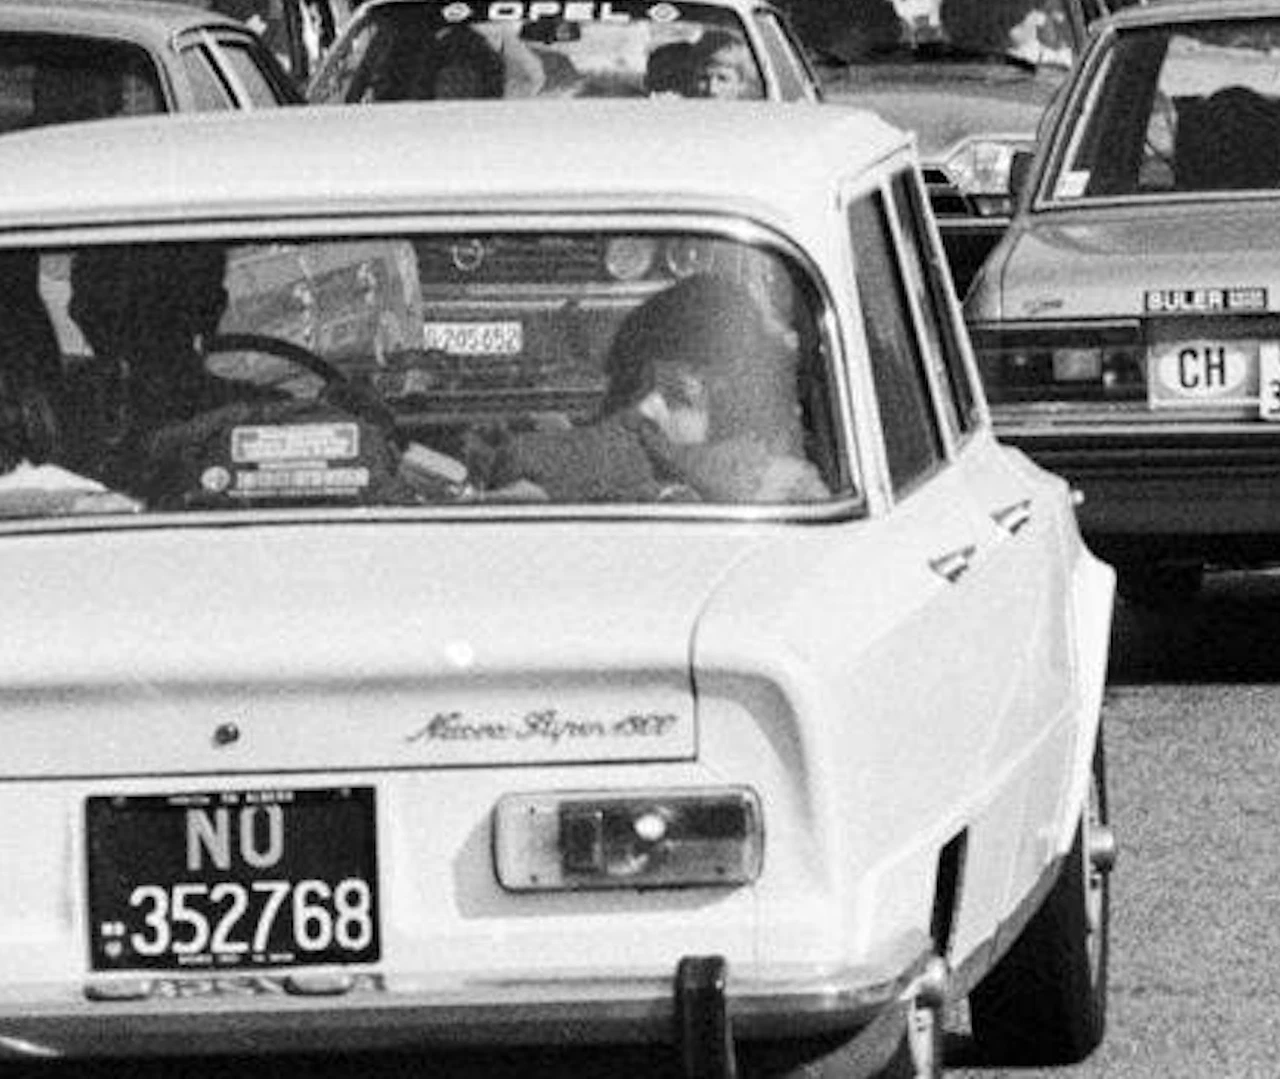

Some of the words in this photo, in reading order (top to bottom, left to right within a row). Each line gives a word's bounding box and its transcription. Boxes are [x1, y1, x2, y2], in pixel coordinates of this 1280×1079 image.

[487, 1, 631, 21] OPEL
[1178, 346, 1226, 388] CH
[185, 804, 285, 871] NO
[129, 878, 372, 957] 352768
